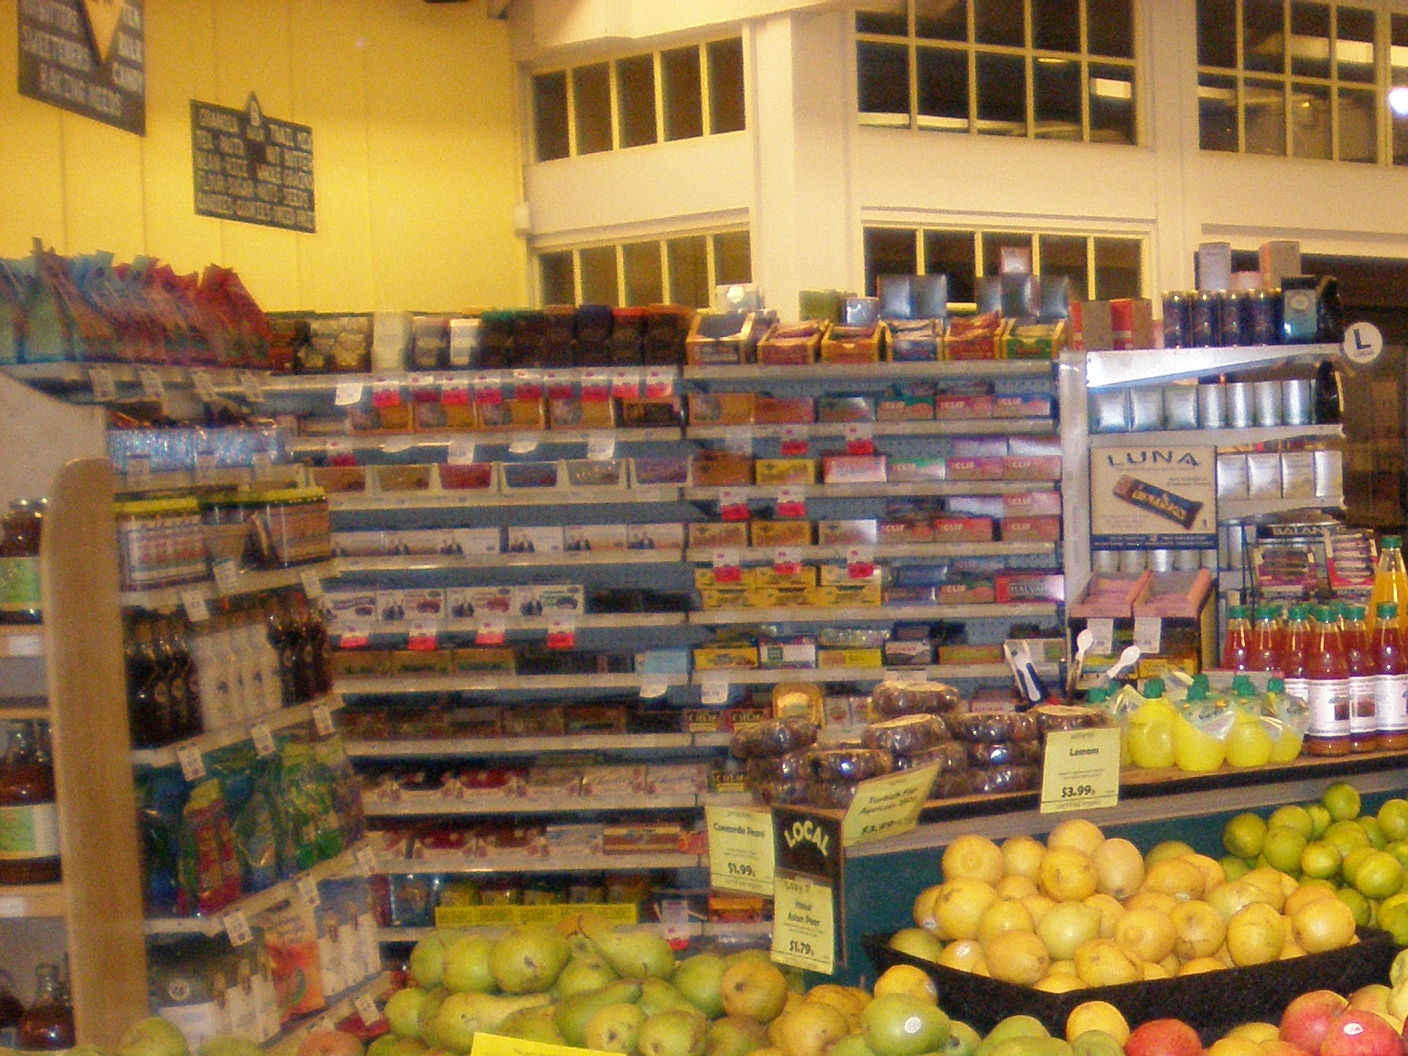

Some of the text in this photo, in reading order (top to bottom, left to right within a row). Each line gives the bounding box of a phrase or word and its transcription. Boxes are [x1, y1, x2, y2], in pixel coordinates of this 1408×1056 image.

[1107, 450, 1199, 467] LUNA
[1061, 785, 1092, 798] $3.99
[783, 820, 830, 857] LOCAL
[727, 862, 753, 876] $1.99
